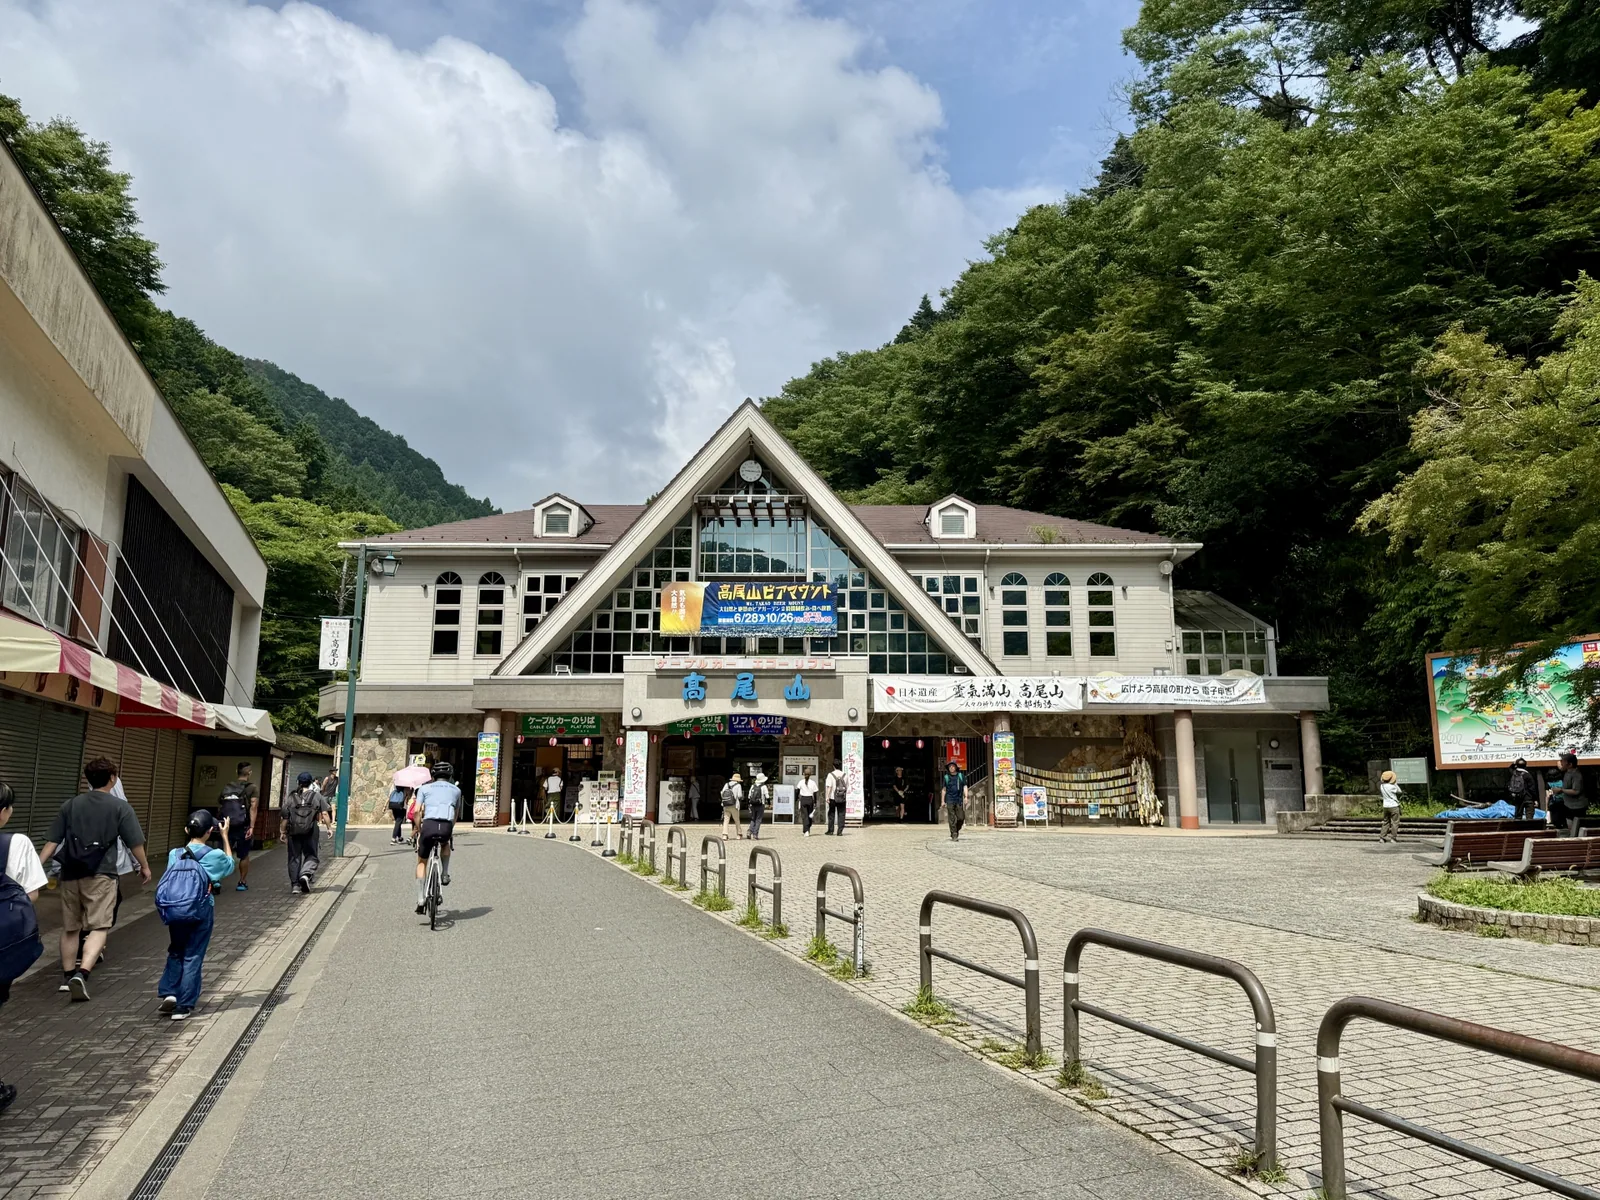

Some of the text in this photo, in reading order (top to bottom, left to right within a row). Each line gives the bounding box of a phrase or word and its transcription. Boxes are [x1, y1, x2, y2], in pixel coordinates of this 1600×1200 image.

[718, 584, 832, 600] 高尾山ビアマウント
[328, 639, 340, 668] 高尾山
[656, 658, 737, 669] ケーブルカー
[681, 671, 811, 701] 高尾山
[899, 688, 938, 697] 日本遺産
[1019, 683, 1064, 699] 高尾山
[1121, 684, 1200, 695] 広げよう高尾の町から
[528, 716, 596, 725] ケーブルカーのりば
